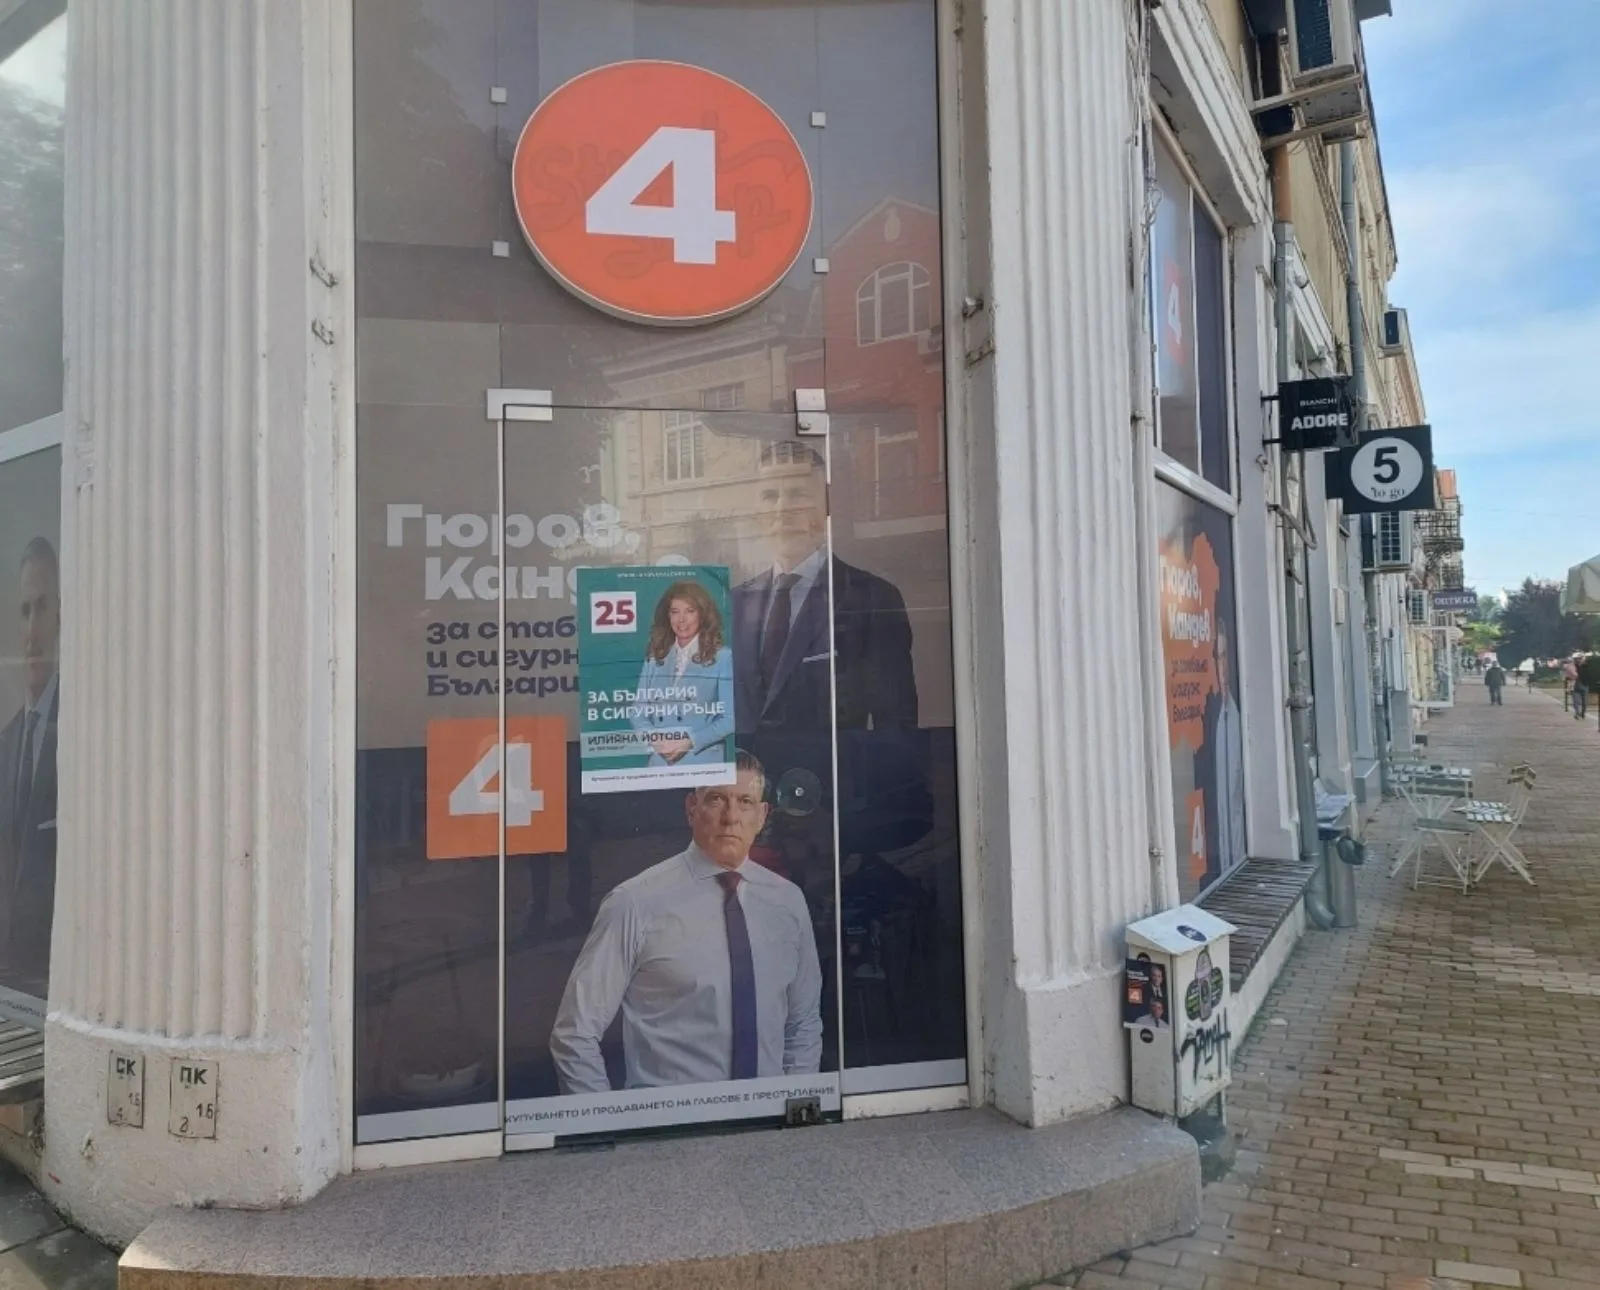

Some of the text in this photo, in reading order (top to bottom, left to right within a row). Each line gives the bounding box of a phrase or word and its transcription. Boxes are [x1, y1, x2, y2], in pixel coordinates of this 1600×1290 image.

[585, 126, 736, 265] 4
[1291, 412, 1349, 431] ADORE
[1373, 446, 1400, 484] 5
[387, 503, 641, 556] Гюров,
[594, 599, 636, 627] 25
[426, 615, 577, 645] за стаб
[426, 648, 579, 671] и сигурн
[427, 674, 580, 698] Българи
[587, 686, 698, 704] ЗА БЪЛГАРИЯ
[587, 701, 726, 721] В СИГУРНИ РЪЦЕ
[588, 734, 638, 745] ИЛИЯНА
[449, 742, 545, 827] 4
[116, 1057, 136, 1076] СК
[180, 1065, 208, 1085] ПК
[581, 1108, 591, 1117] И
[592, 1100, 675, 1115] ПРОДАВАНЕТО
[676, 1097, 692, 1107] НА
